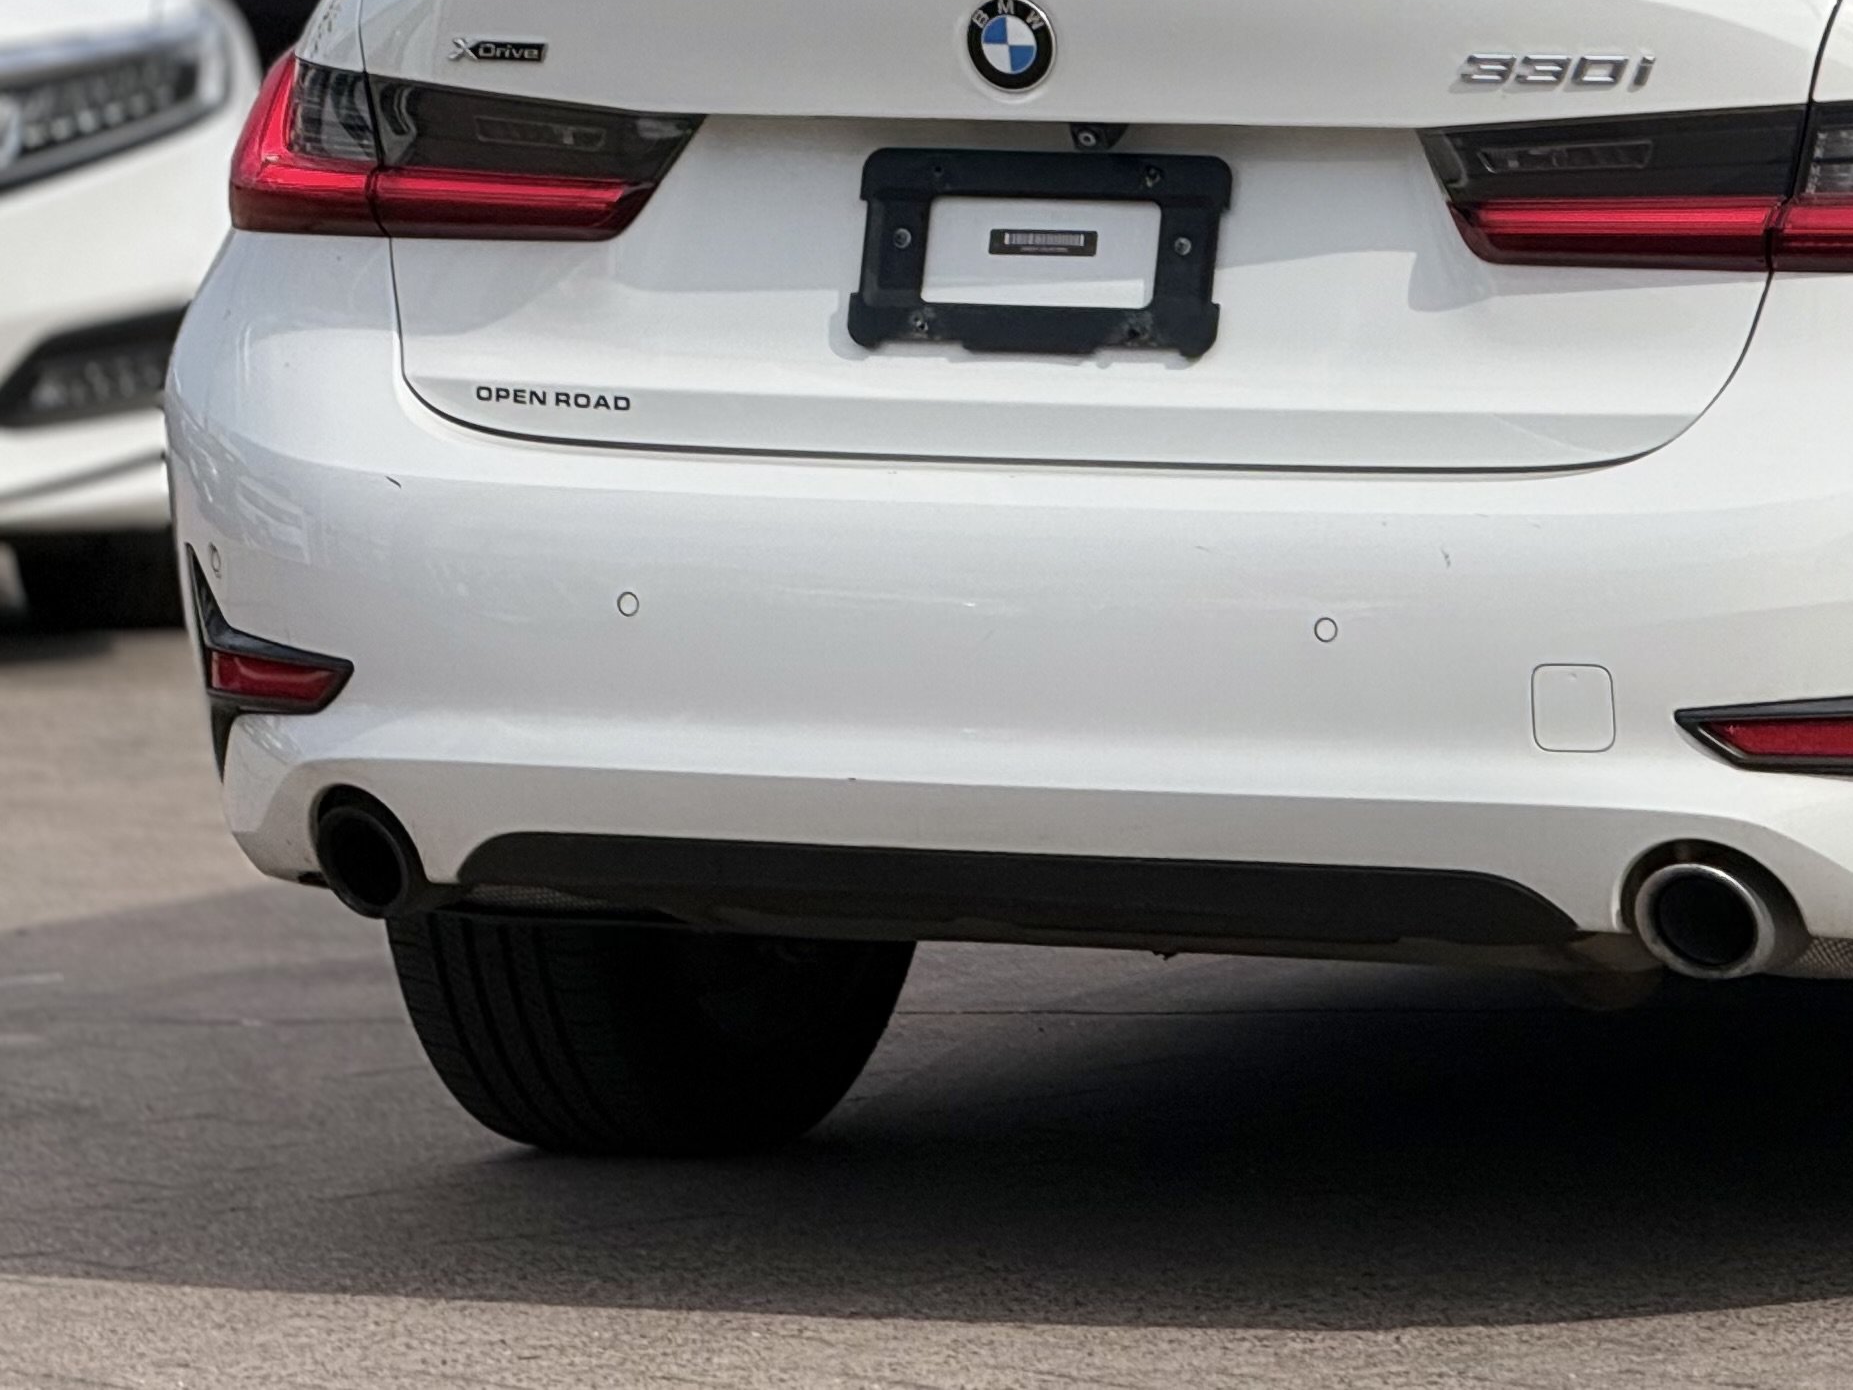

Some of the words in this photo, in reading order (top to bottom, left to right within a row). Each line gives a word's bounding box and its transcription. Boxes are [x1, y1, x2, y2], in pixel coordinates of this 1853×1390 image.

[972, 0, 1044, 30] BMW
[1459, 54, 1656, 86] 330i
[476, 385, 547, 406] OPEN
[555, 391, 631, 411] ROAD
